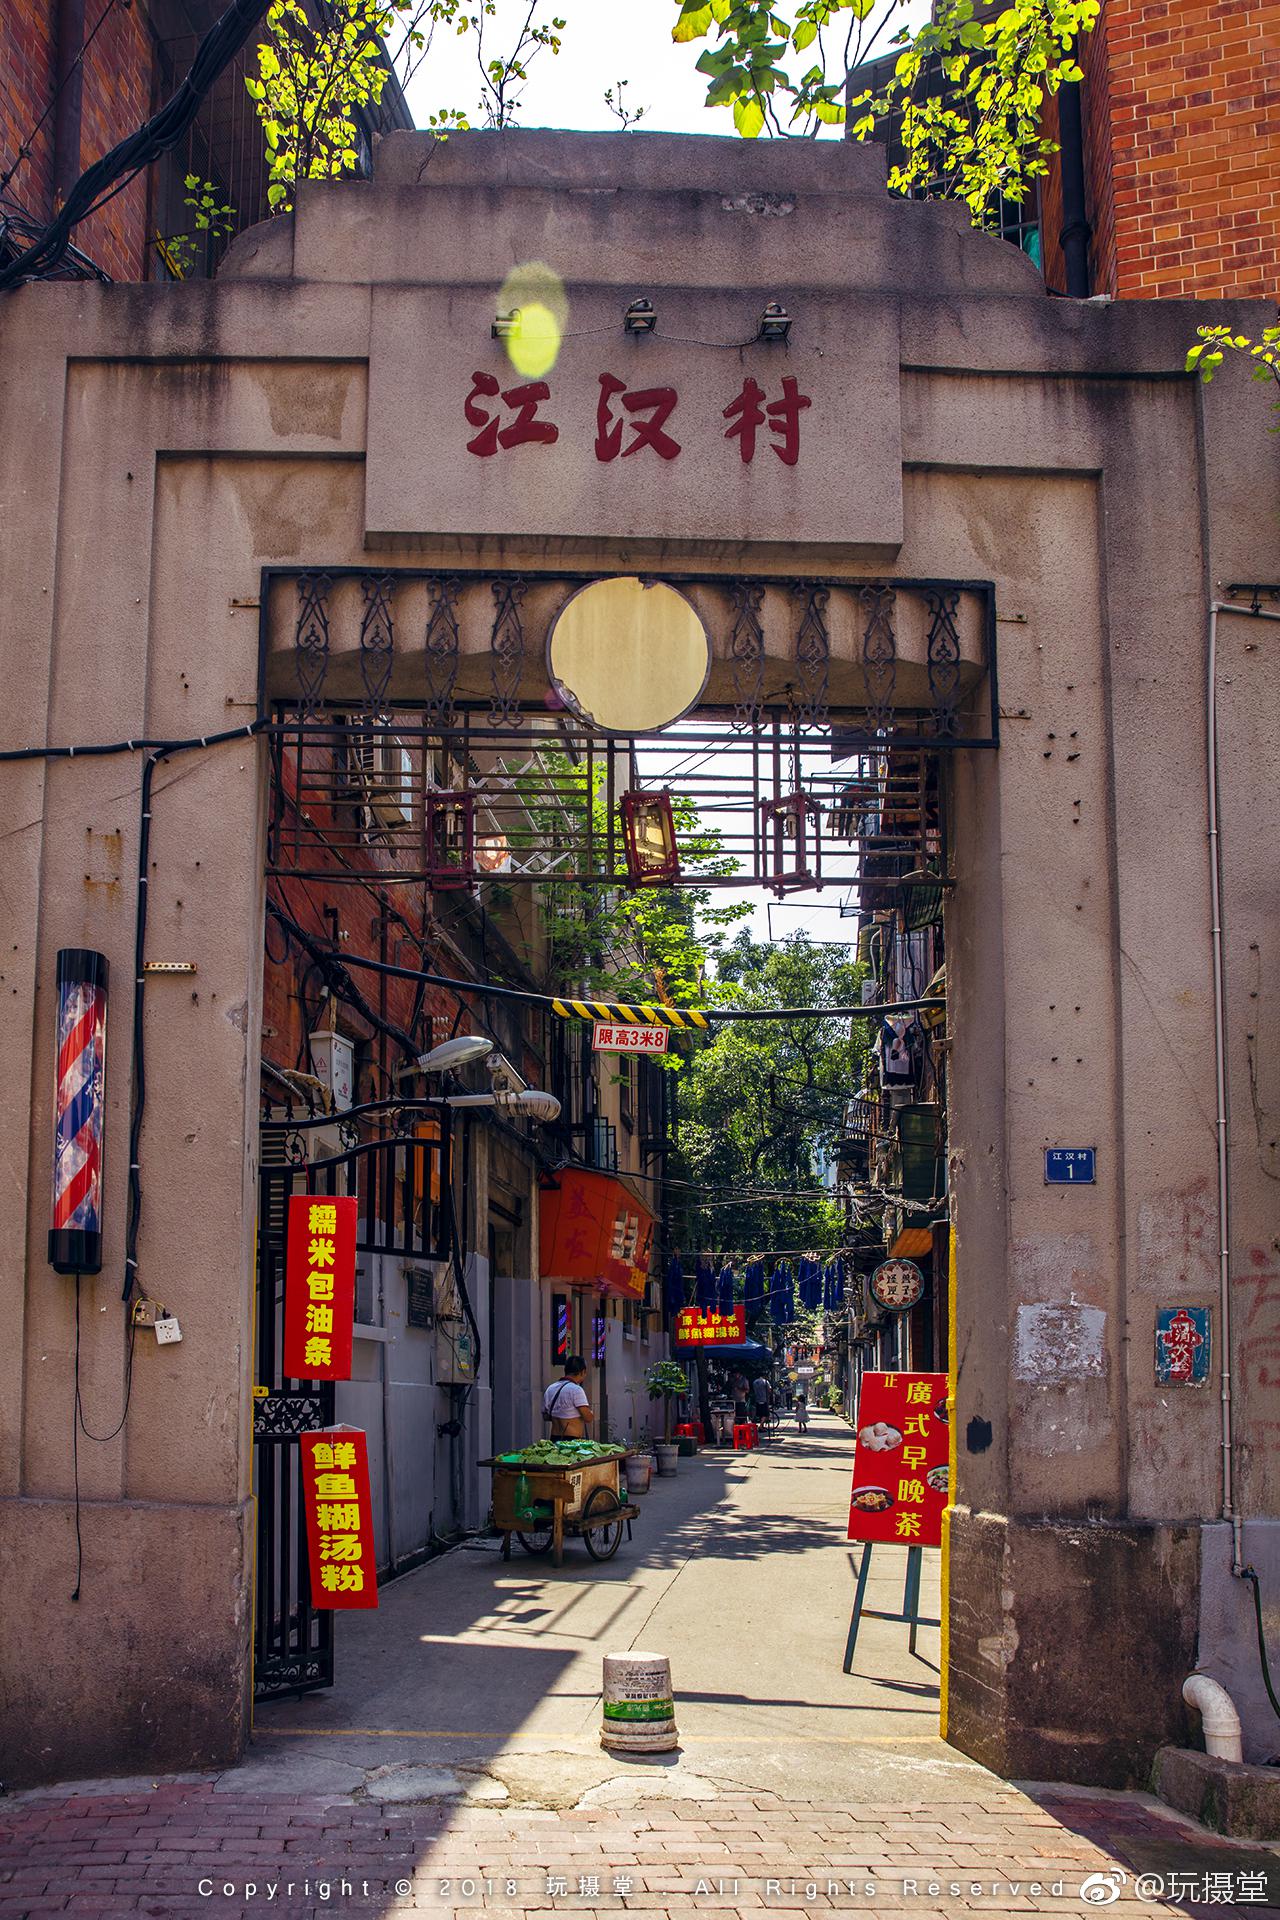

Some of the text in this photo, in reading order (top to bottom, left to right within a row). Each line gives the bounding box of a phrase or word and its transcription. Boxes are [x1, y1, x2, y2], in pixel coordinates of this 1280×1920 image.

[464, 370, 812, 466] 江汉村
[599, 1028, 664, 1048] 限高3米8
[1052, 1152, 1087, 1161] 江汉村
[1066, 1164, 1073, 1179] 1
[304, 1204, 337, 1366] 糯米包油条
[895, 1381, 933, 1537] 廣式早晚茶
[311, 1442, 365, 1592] 鲜鱼糊汤粉
